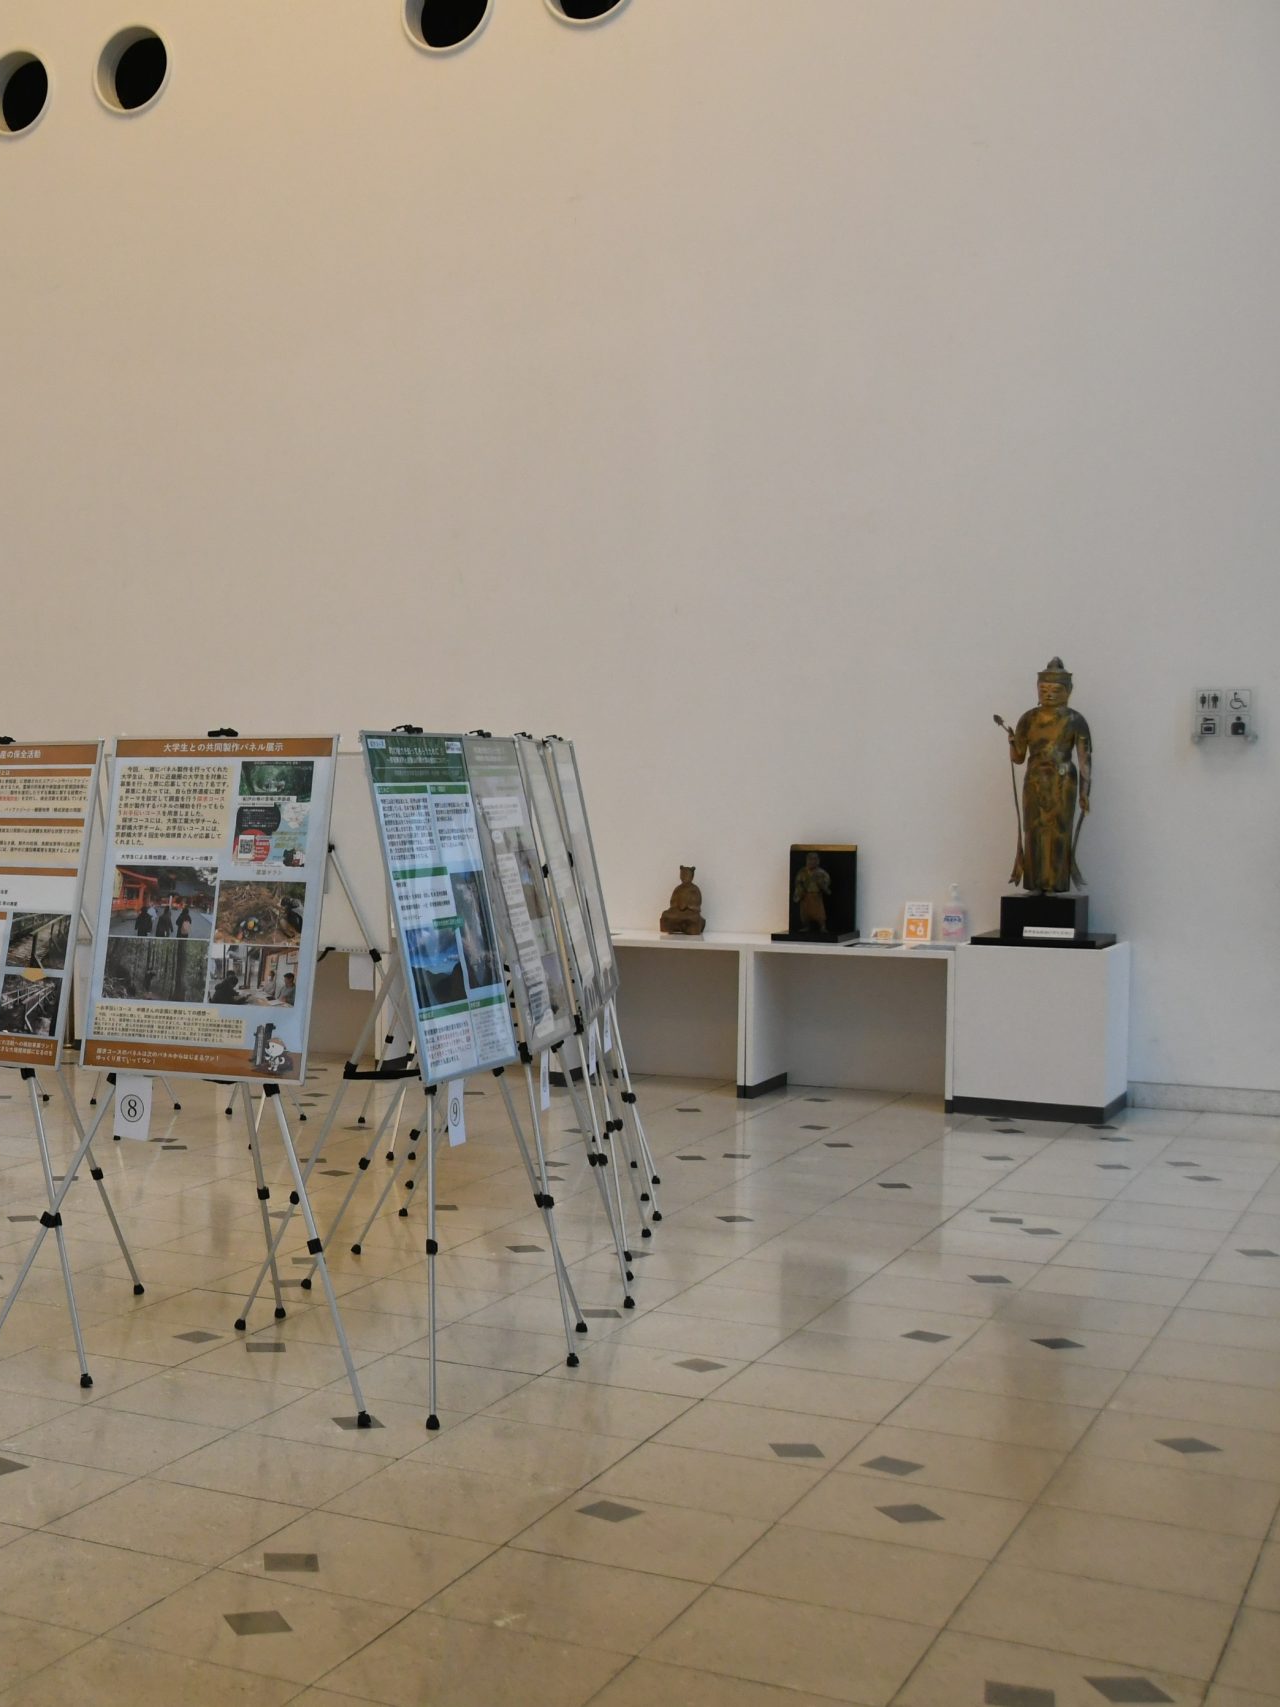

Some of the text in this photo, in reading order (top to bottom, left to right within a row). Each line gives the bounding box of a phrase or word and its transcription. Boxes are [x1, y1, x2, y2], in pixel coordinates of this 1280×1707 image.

[163, 743, 284, 752] 大学生との共同製作パネル展示
